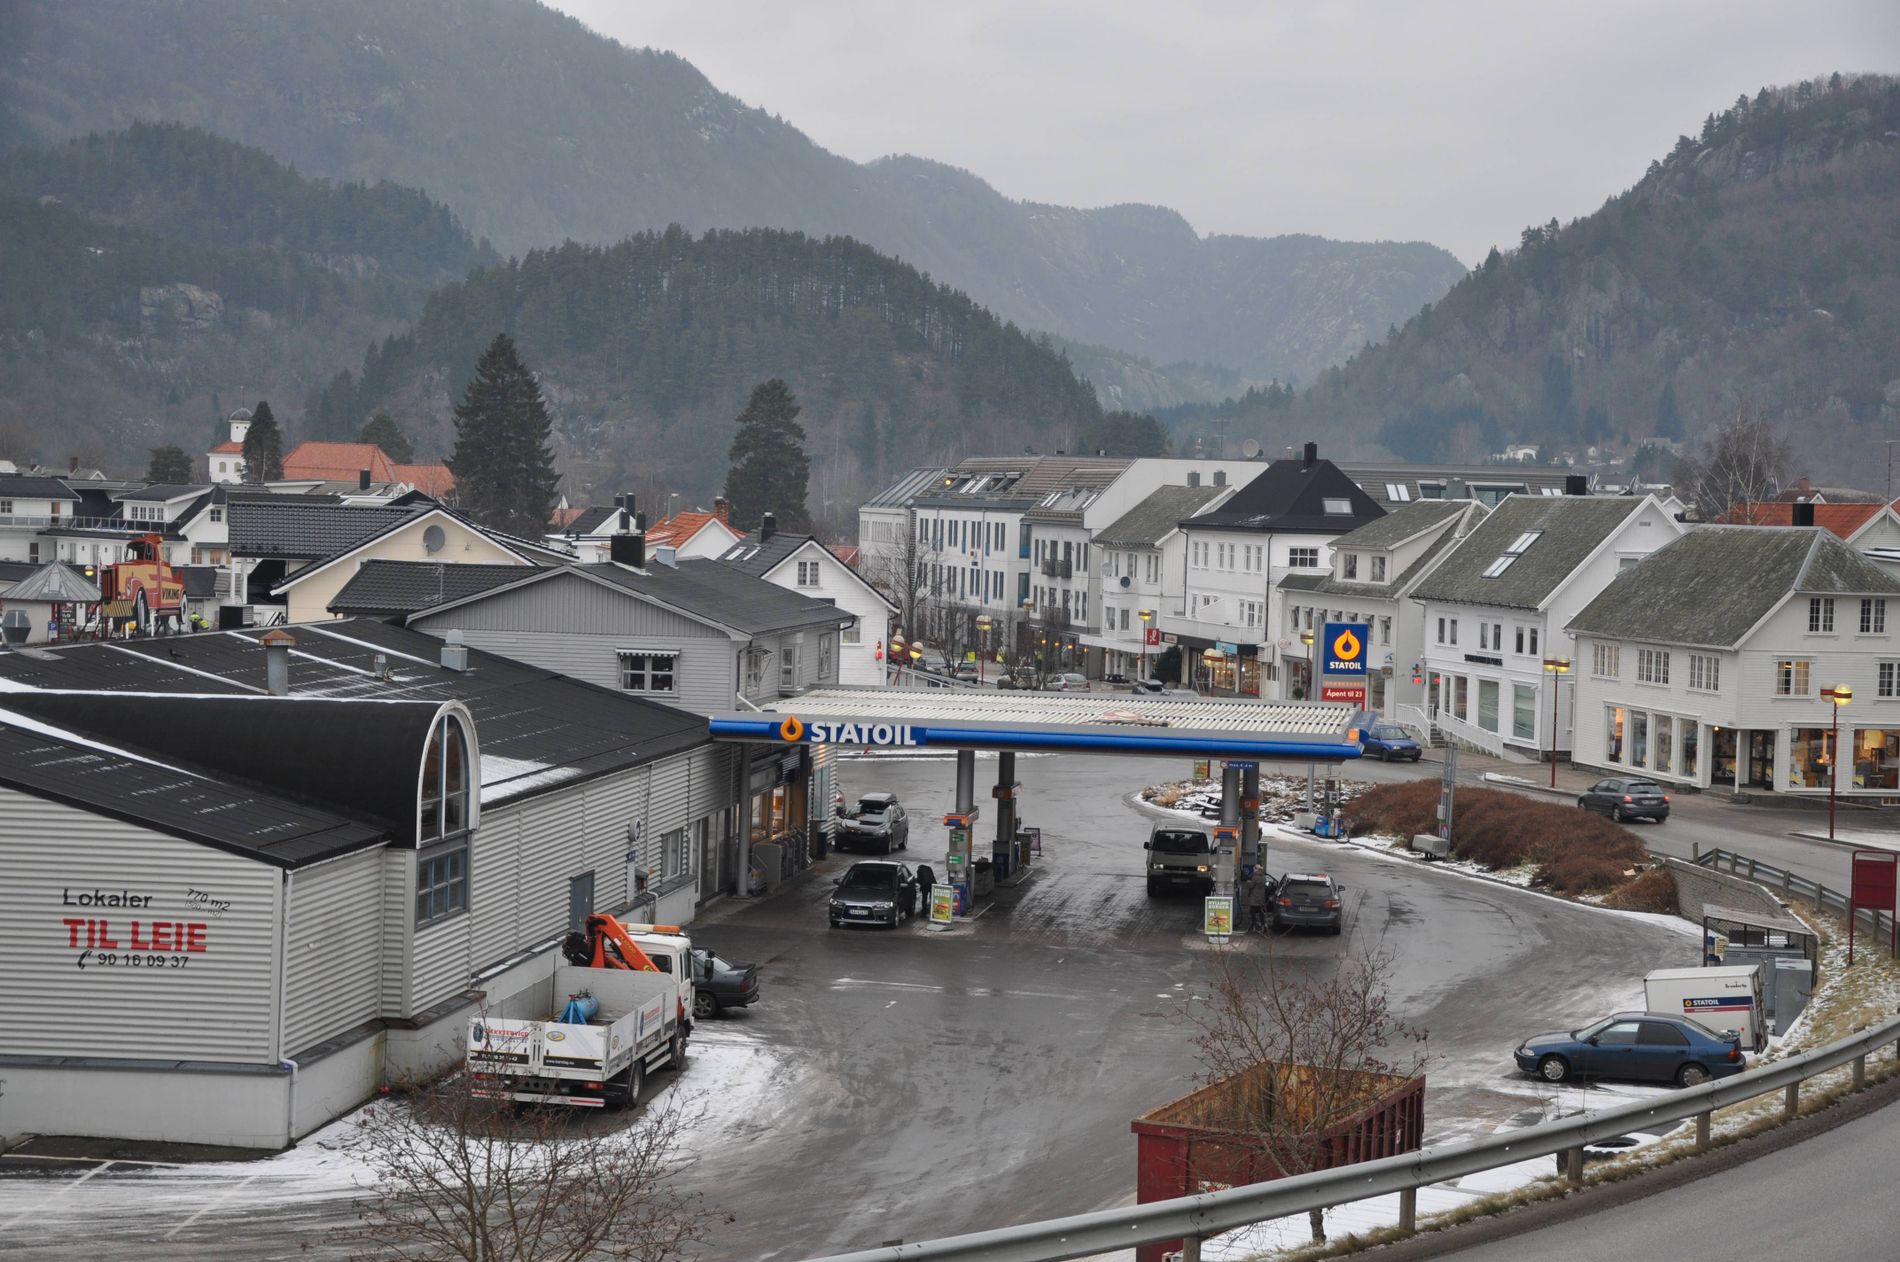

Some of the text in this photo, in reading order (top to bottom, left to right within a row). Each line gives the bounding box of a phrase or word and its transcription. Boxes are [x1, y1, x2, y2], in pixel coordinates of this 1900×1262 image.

[161, 588, 180, 600] VIKING
[1329, 661, 1362, 670] STATOIL
[1326, 689, 1346, 698] Åpent
[810, 721, 917, 746] STATOIL
[62, 888, 153, 909] Lokaler
[187, 887, 209, 903] 770
[211, 899, 231, 912] m2
[63, 918, 208, 953] TIL LEIE
[97, 953, 190, 969] 90 16 09 37
